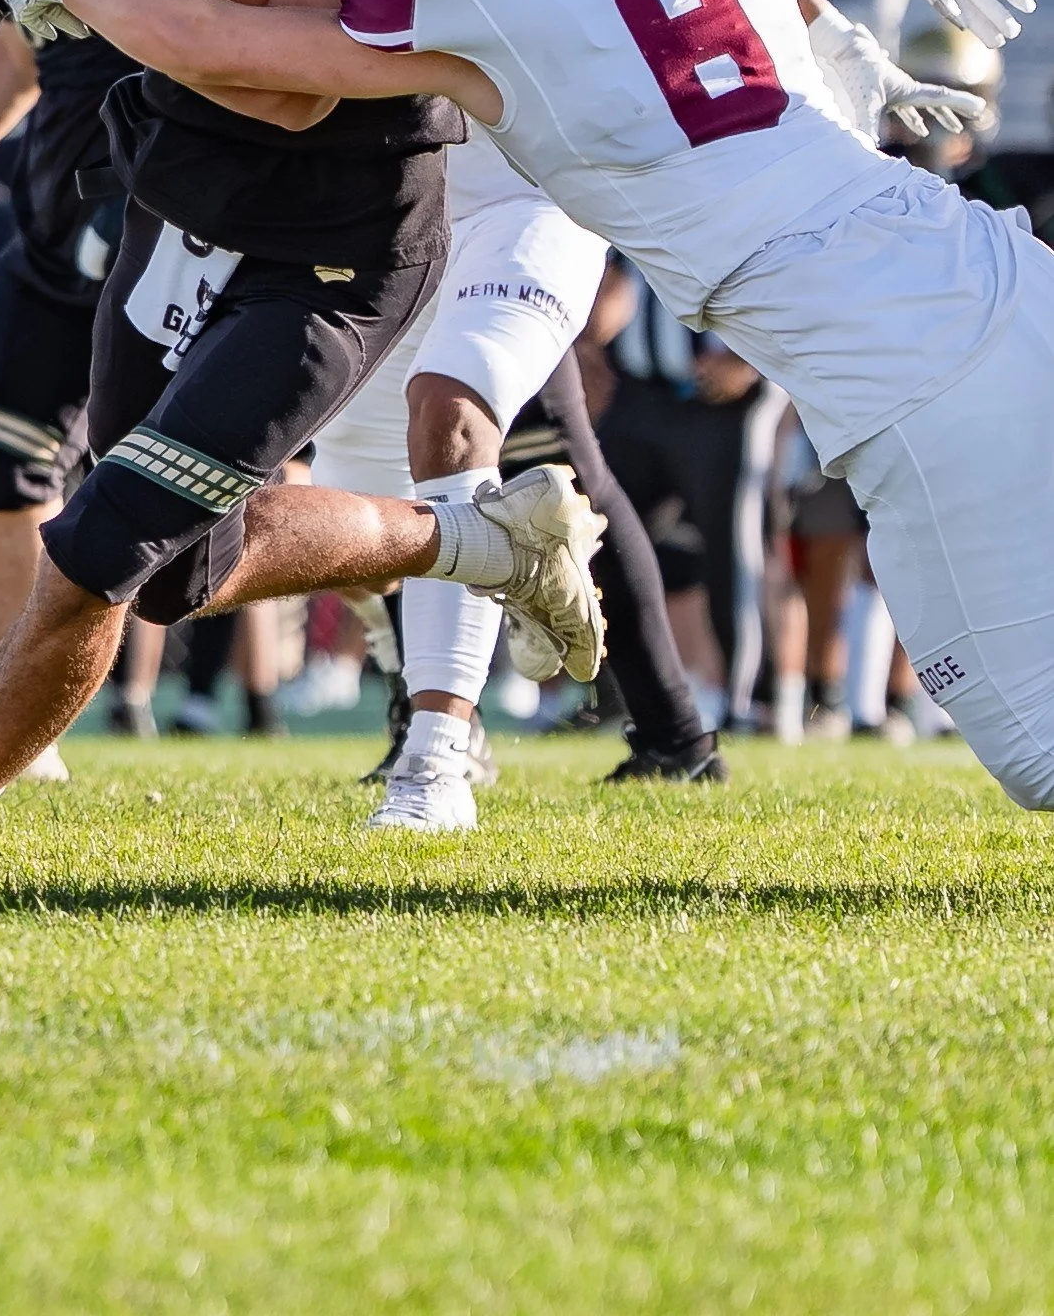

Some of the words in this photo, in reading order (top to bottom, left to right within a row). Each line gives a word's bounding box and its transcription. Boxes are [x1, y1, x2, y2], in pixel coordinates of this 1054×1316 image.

[457, 282, 509, 301] MEAN
[518, 285, 571, 330] MOOSE
[917, 656, 966, 696] OOSE
